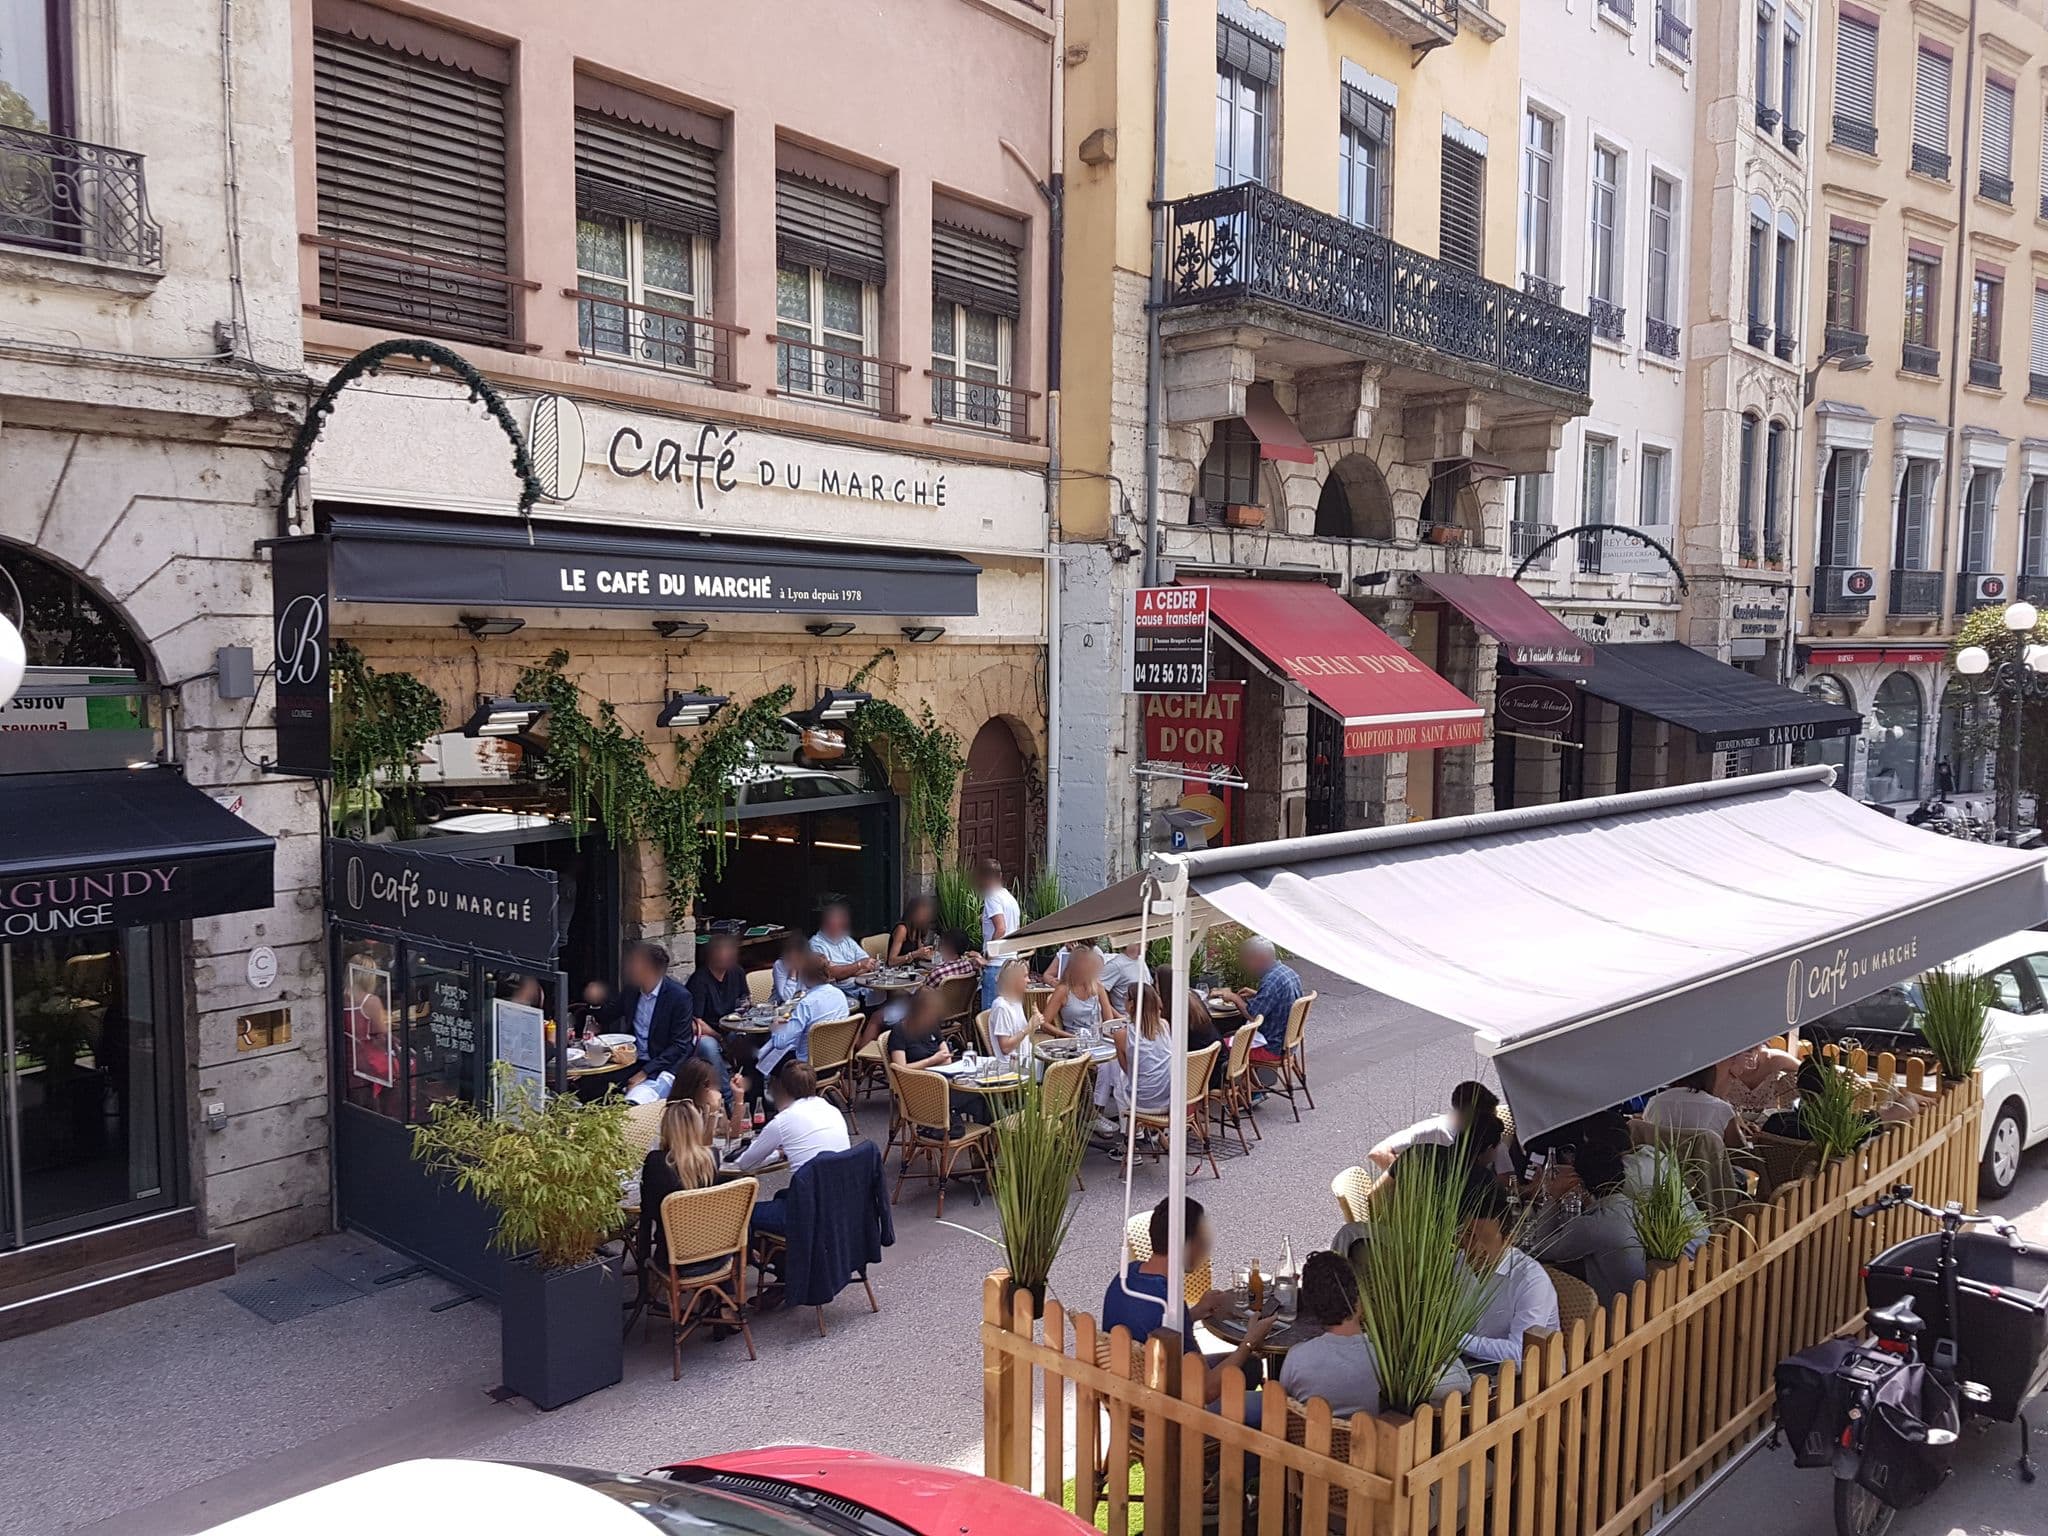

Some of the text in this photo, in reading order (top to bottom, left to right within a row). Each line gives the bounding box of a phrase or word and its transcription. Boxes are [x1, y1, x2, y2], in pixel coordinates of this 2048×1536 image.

[608, 424, 947, 510] Café DU MARCHÉ
[560, 568, 862, 603] LE CAFÉ DU MARCHÉ à Lyon depuis 1978
[1144, 590, 1198, 610] A CEDER
[1136, 611, 1205, 625] cause transfert
[276, 593, 327, 685] B
[1282, 653, 1423, 676] ACHAT D'OR
[1517, 646, 1527, 663] La
[1556, 646, 1581, 663] Blanche
[1135, 663, 1203, 683] 04 72 56 73 73
[1147, 693, 1240, 720] ACHAT
[1160, 726, 1224, 755] D'OR
[1345, 721, 1482, 750] COMPTOIR D'OR SAINT ANTOINE
[1769, 723, 1815, 745] BAROCO
[1175, 830, 1185, 847] P
[371, 868, 532, 922] Café DU MARCHÉ
[1808, 935, 1918, 1005] Café DU MARCHÉ
